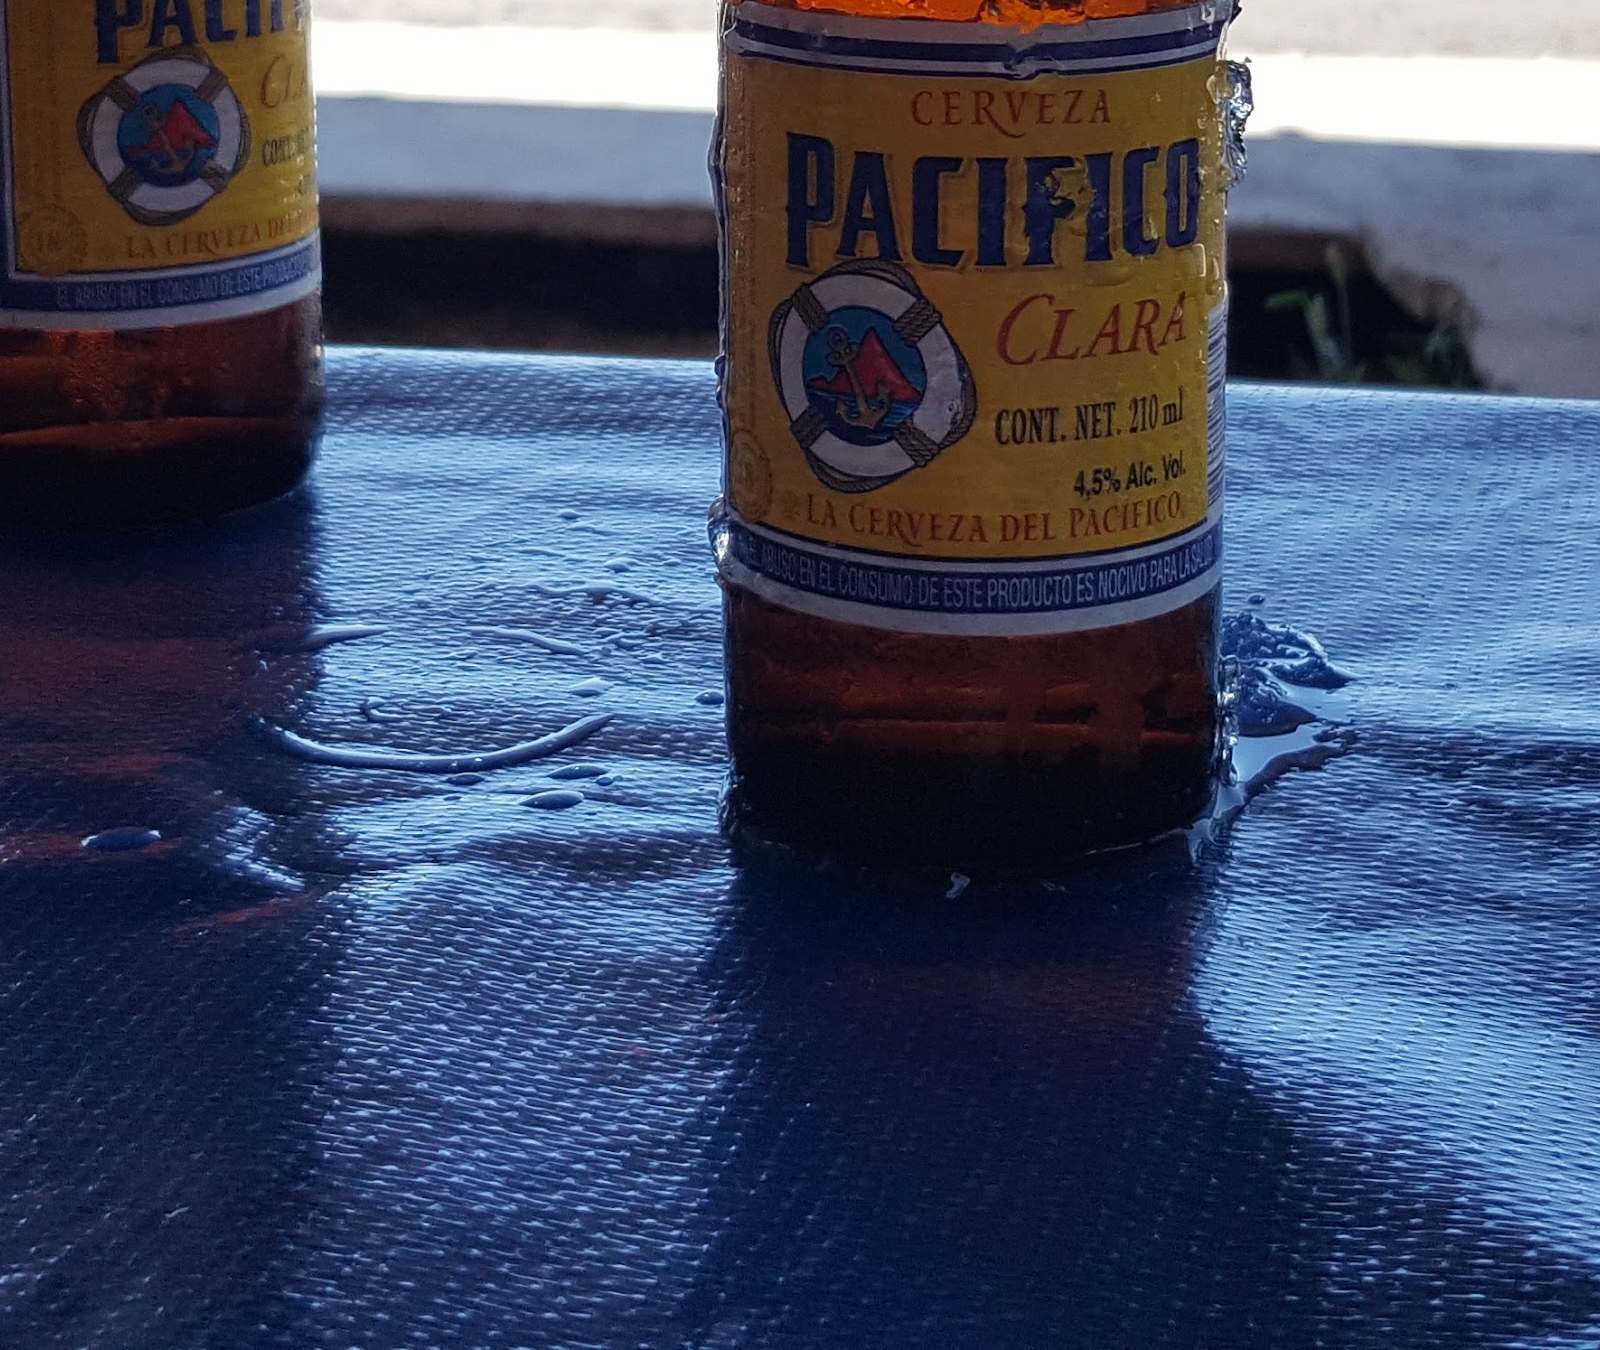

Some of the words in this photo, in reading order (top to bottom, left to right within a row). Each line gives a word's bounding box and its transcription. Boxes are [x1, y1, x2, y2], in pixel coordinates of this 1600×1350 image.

[911, 89, 1112, 138] CERVEZA
[786, 131, 1199, 268] PACIFICO
[997, 290, 1187, 366] CLARA
[994, 407, 1067, 445] CONT.
[1074, 402, 1122, 441] NET.
[1128, 394, 1159, 434] 210
[1162, 386, 1185, 426] ml
[1126, 460, 1157, 490] Alc.
[1162, 450, 1187, 481] Vol.
[807, 493, 837, 529] LA
[849, 504, 989, 547] CERVEZA
[999, 512, 1056, 543] DEL
[818, 561, 836, 592] EL
[838, 565, 913, 604] CONSUMO
[918, 575, 940, 606] DE
[943, 576, 983, 608] ESTE
[987, 574, 1073, 608] PRODUCTO
[1076, 570, 1095, 602] ES
[1099, 562, 1149, 599] NOCIVO
[1151, 550, 1178, 589] PARA
[1178, 547, 1190, 579] LA
